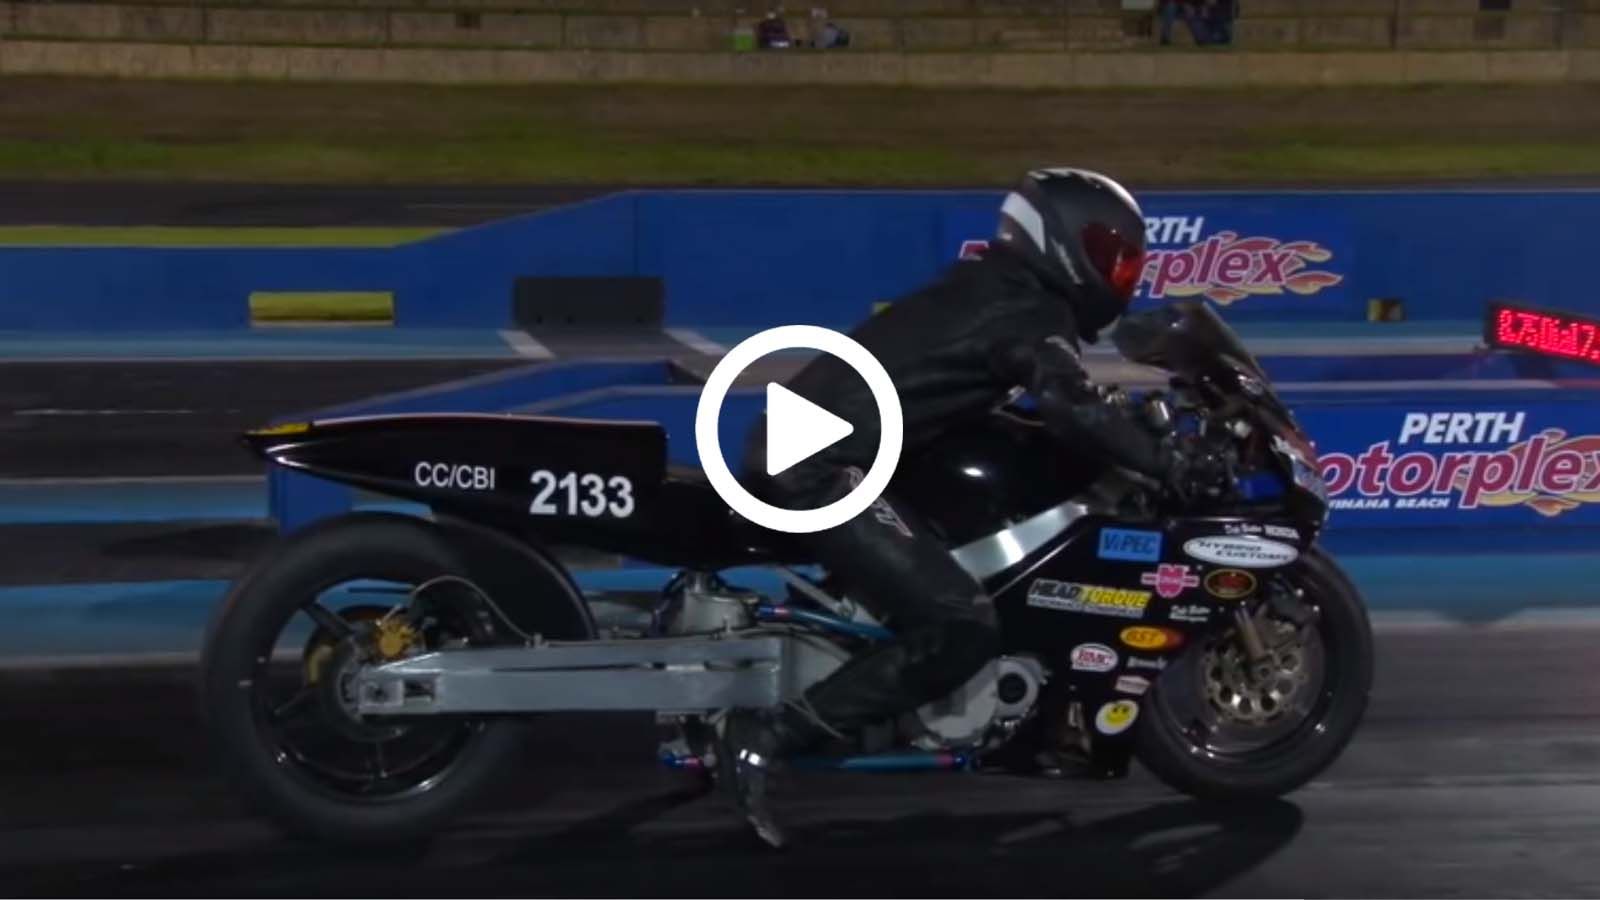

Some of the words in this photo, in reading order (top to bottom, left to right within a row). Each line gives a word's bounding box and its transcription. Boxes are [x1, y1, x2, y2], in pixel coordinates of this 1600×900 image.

[1144, 217, 1205, 244] RTH
[1398, 412, 1525, 445] PERTH
[414, 461, 496, 490] CC/CBI
[1314, 434, 1600, 509] otorplex
[529, 469, 635, 518] 2133
[1394, 498, 1451, 509] BEACH
[1082, 586, 1149, 610] TORQUE
